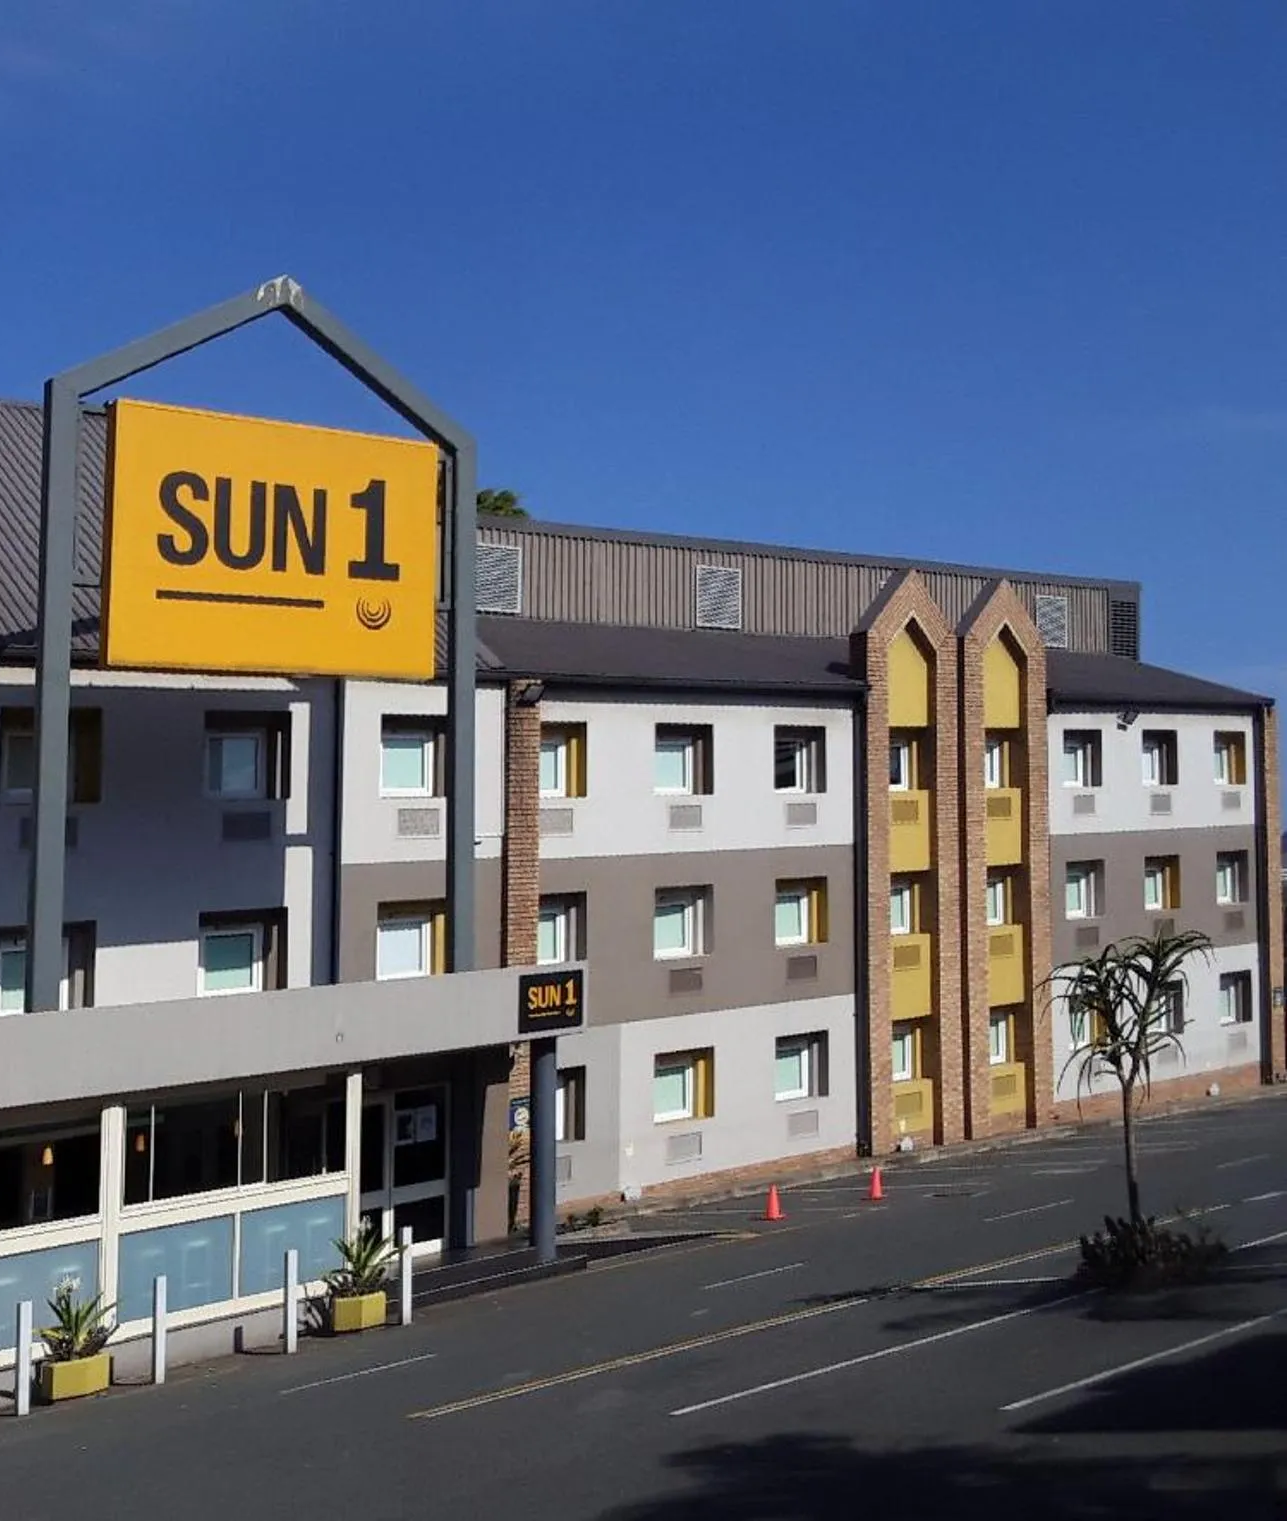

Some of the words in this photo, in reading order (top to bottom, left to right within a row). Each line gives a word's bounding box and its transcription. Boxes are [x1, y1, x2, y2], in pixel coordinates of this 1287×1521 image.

[157, 470, 327, 576] SUN
[347, 479, 400, 581] 1
[528, 984, 561, 1009] SUN
[565, 978, 577, 1005] 1
